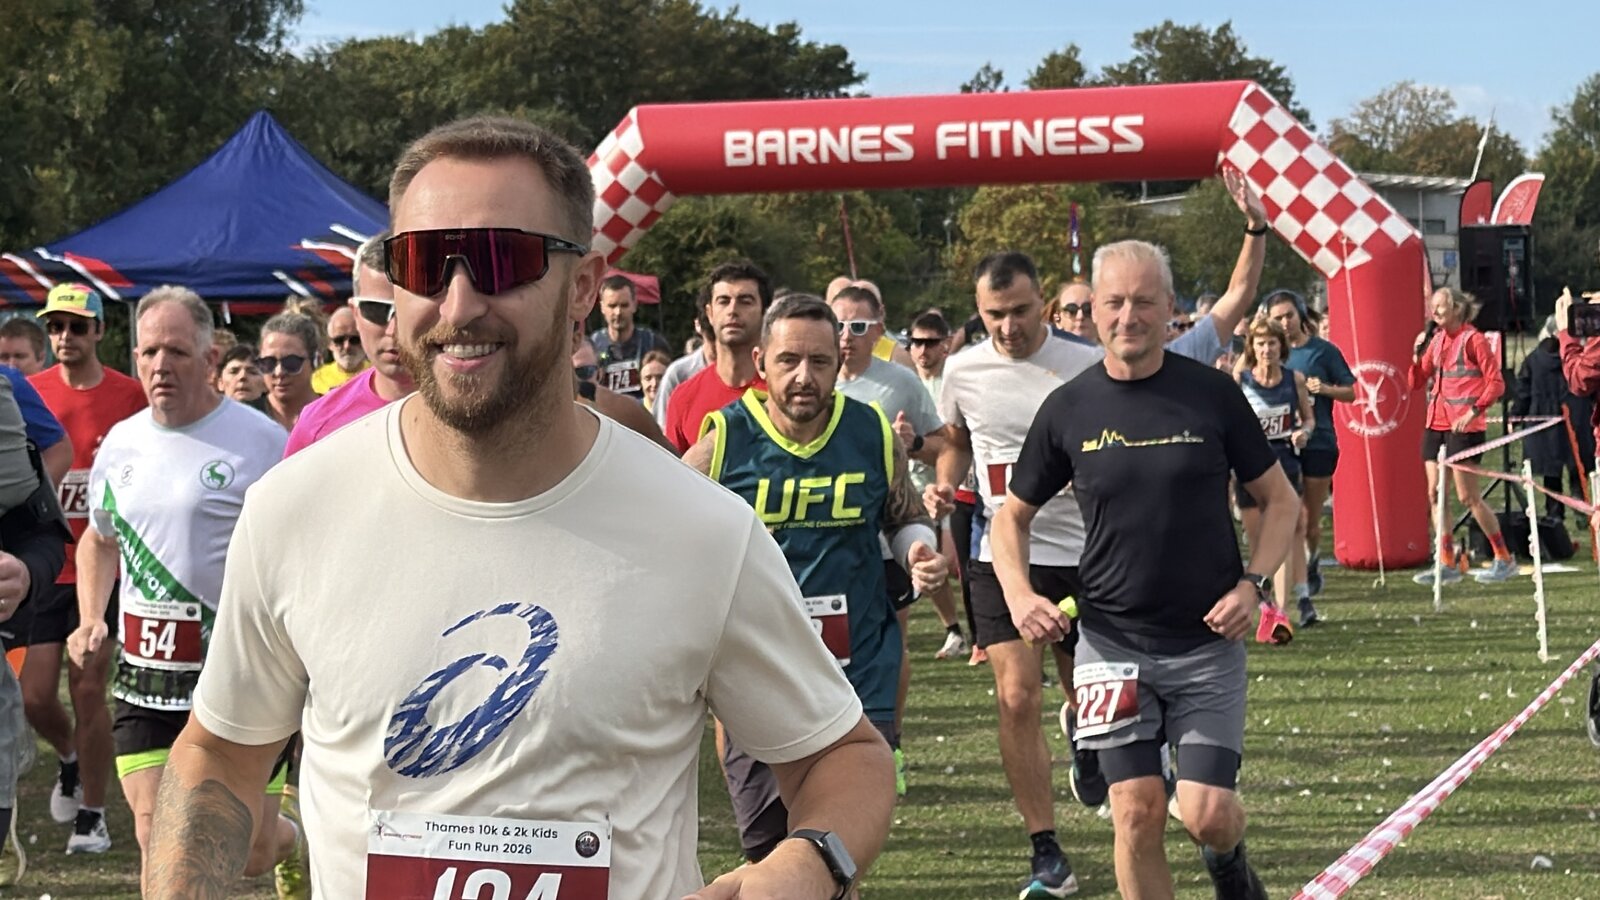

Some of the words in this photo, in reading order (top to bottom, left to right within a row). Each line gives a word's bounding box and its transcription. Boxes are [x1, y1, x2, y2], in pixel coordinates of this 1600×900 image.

[724, 125, 915, 167] BARNES
[936, 115, 1145, 161] FITNESS
[609, 369, 631, 390] 174
[755, 472, 866, 523] UFC
[139, 619, 177, 660] 54
[1076, 680, 1124, 729] 227
[425, 821, 475, 834] Thames
[479, 824, 498, 835] 10k
[502, 826, 511, 837] &
[514, 827, 528, 838] 2k
[532, 828, 558, 839] Kids
[448, 840, 471, 851] Fun
[475, 841, 499, 853] Run
[503, 843, 532, 855] 2026
